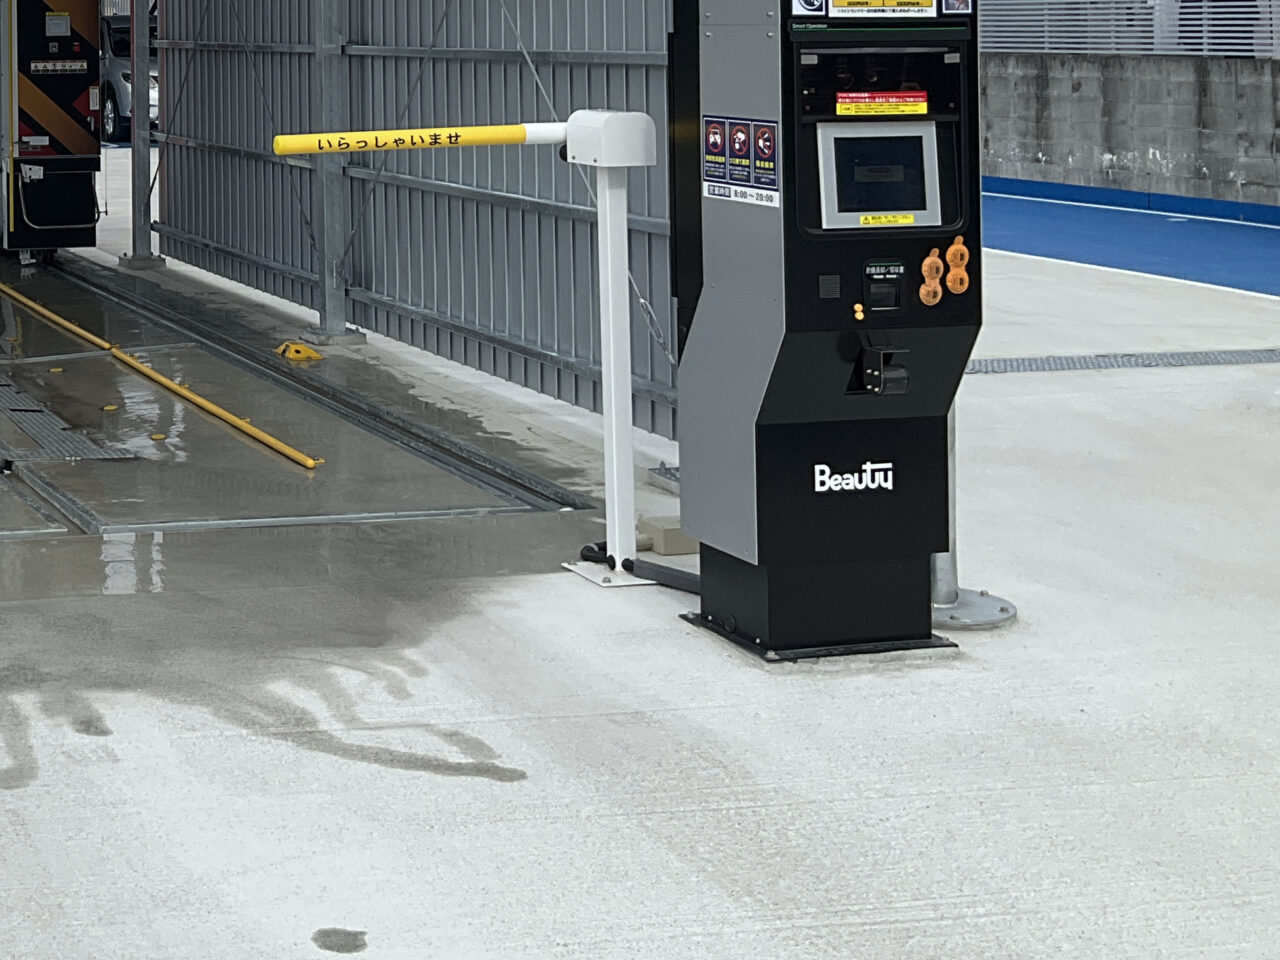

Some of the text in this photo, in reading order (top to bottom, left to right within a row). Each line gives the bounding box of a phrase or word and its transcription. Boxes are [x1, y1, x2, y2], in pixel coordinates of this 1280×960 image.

[317, 132, 462, 151] いらっしゃいませ
[814, 461, 893, 492] Beauty
